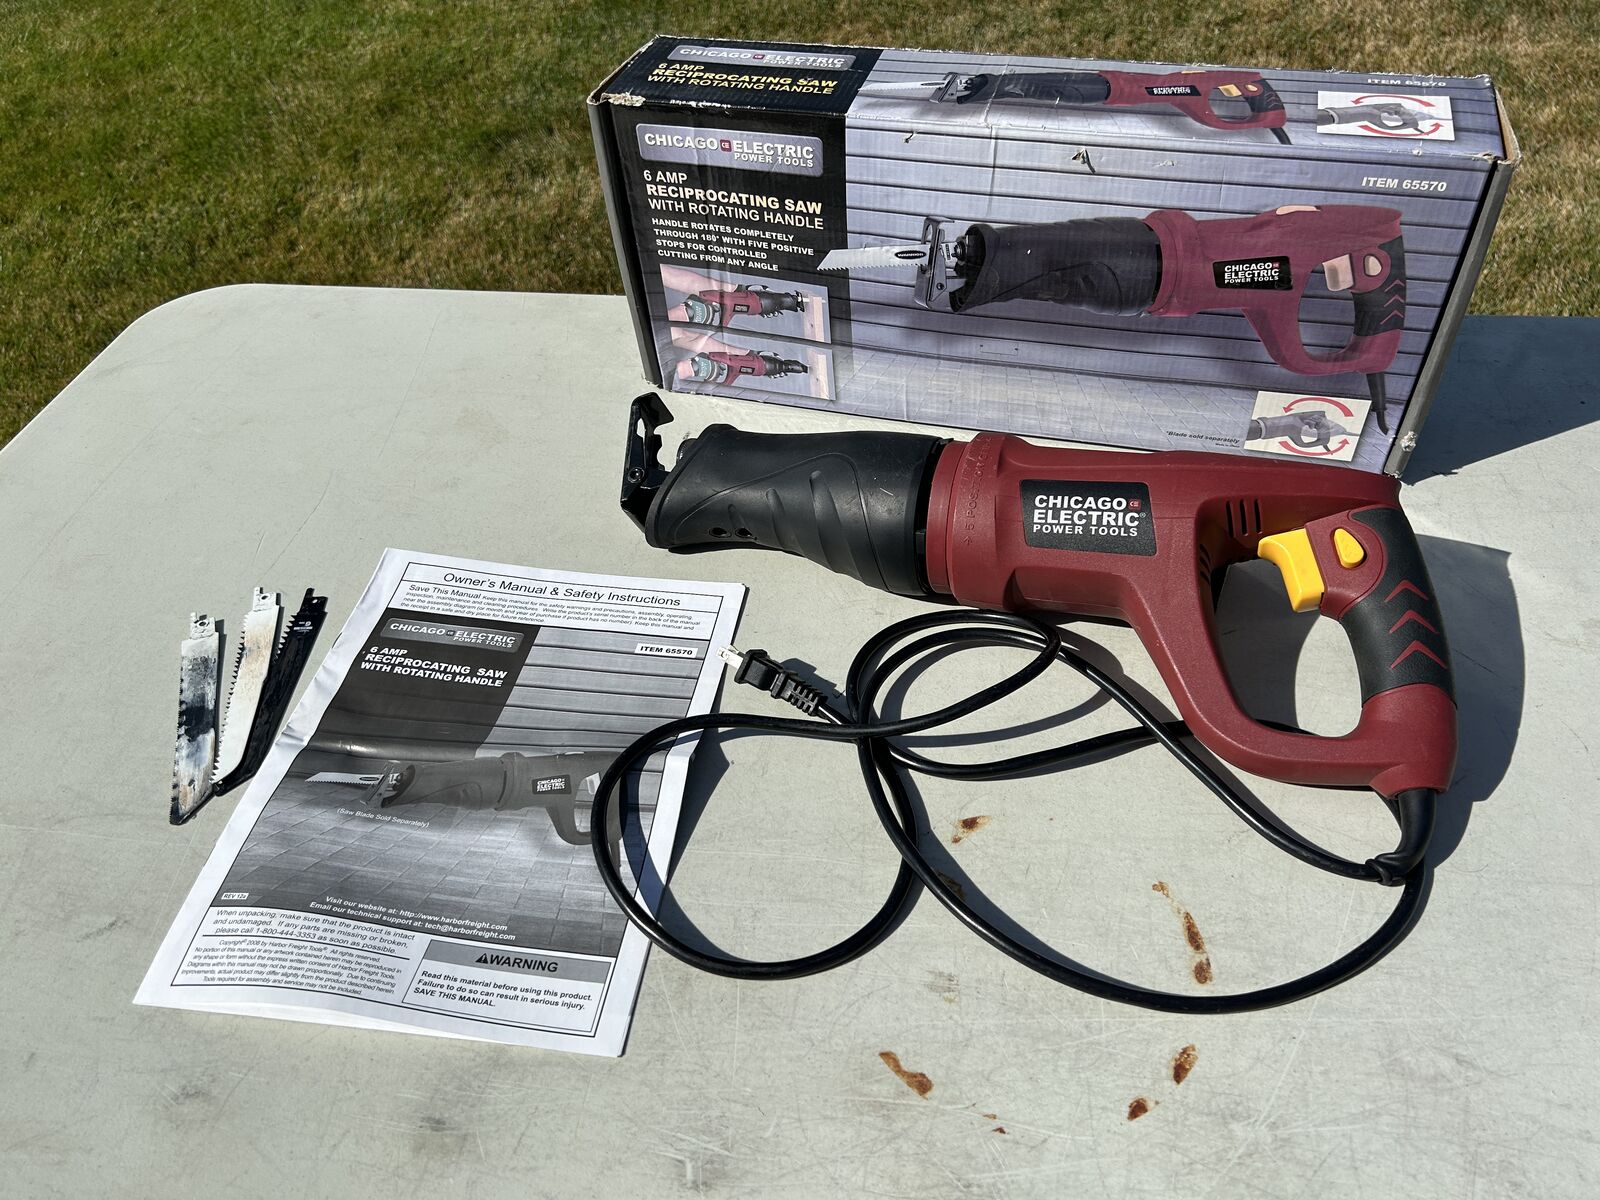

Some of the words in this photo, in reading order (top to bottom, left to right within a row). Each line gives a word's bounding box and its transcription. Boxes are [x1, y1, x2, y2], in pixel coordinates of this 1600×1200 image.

[679, 49, 750, 59] CHICAGO
[765, 54, 845, 65] ELECTRIC
[652, 69, 793, 84] RECIPROCATING
[796, 78, 838, 87] SAW
[693, 78, 765, 90] ROTATING
[768, 82, 834, 94] HANDLE
[644, 133, 718, 149] CHICAGO
[732, 140, 813, 159] ELECTRIC
[734, 152, 773, 163] POWER
[777, 157, 813, 167] TOOLS
[643, 170, 652, 181] 6
[656, 171, 688, 184] AMP
[1361, 177, 1399, 189] ITEM
[1402, 179, 1447, 192] 65570
[646, 184, 779, 208] RECIPROCATING
[784, 199, 822, 214] SAW
[648, 199, 684, 212] WITH
[689, 201, 759, 221] ROTATING
[764, 211, 824, 229] HANDLE
[652, 218, 689, 228] HANDLE
[691, 222, 731, 233] ROTATES
[734, 227, 794, 242] COMPLETELY
[654, 229, 698, 240] THROUGH
[722, 236, 745, 246] WITH
[748, 240, 769, 249] FIVE
[771, 243, 814, 255] POSITIVE
[656, 239, 685, 249] STOPS
[687, 242, 705, 251] FOR
[708, 245, 767, 259] CONTROLLED
[658, 250, 698, 260] CUTTING
[700, 254, 725, 263] FROM
[727, 258, 746, 266] ANY
[748, 261, 779, 271] ANGLE
[1225, 263, 1272, 272] CHICAGO
[1224, 269, 1279, 279] ELECTRIC
[1206, 435, 1240, 443] separately
[1034, 495, 1127, 510] CHICAGO
[1033, 525, 1083, 534] POWER
[1090, 526, 1138, 536] TOOLS
[444, 573, 495, 588] Owner's
[499, 581, 547, 594] Manual
[564, 588, 604, 600] Safety
[608, 592, 680, 606] Instructions
[451, 589, 481, 599] Manual
[390, 623, 446, 635] CHICAGO
[454, 631, 515, 643] ELECTRIC
[361, 662, 392, 672] WITH
[393, 667, 451, 681] ROTATING
[455, 675, 503, 687] HANDLE
[365, 654, 470, 673] RECIPROCATING
[477, 669, 507, 678] SAW
[392, 817, 429, 828] Separately)
[310, 902, 331, 910] Email
[347, 907, 381, 919] technical
[382, 913, 411, 926] support
[425, 922, 516, 941] tech@harborfreight.com
[358, 903, 386, 912] website
[400, 910, 507, 931] http://www.harborfreight.com
[256, 928, 316, 939] 1-800-444-3353
[329, 936, 348, 945] soon
[362, 942, 397, 954] possible.
[300, 923, 320, 933] parts
[336, 928, 367, 940] missing
[379, 936, 408, 948] broken,
[353, 924, 383, 935] product
[392, 930, 416, 940] intact
[490, 954, 558, 972] WARNING
[418, 979, 445, 989] Failure
[496, 993, 519, 1002] result
[530, 997, 559, 1006] serious
[561, 1001, 585, 1010] injury.
[422, 970, 442, 979] Read
[460, 977, 492, 987] material
[493, 982, 518, 992] before
[520, 986, 541, 996] using
[560, 992, 592, 1001] product.
[414, 987, 435, 996] SAVE
[438, 991, 456, 1000] THIS
[458, 995, 496, 1007] MANUAL.
